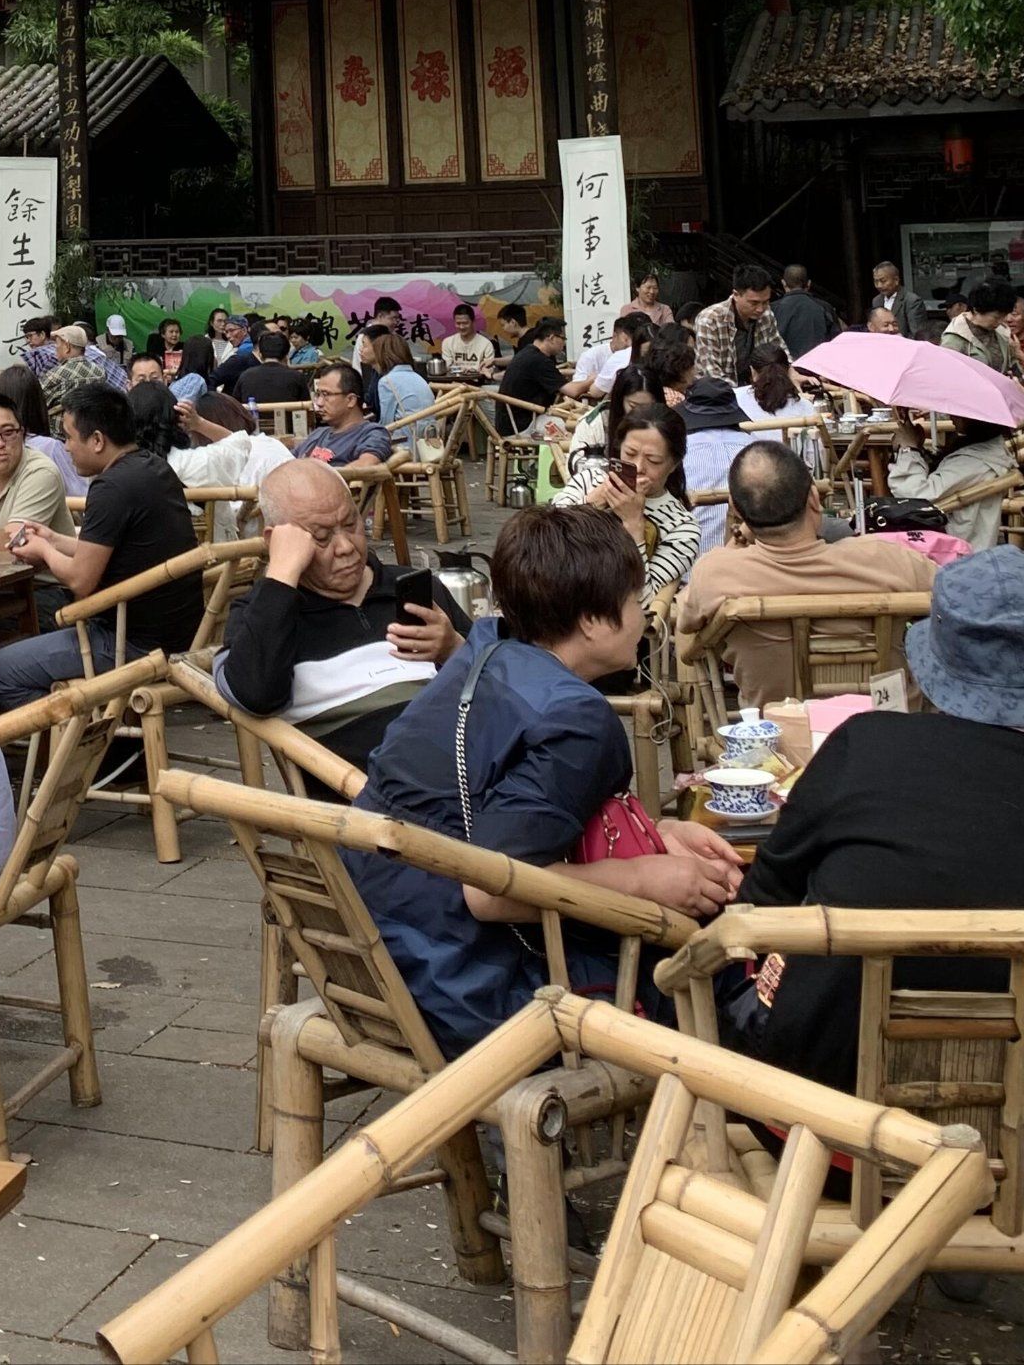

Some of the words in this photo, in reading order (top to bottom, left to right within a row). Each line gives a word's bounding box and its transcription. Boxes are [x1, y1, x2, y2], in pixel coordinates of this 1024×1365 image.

[488, 45, 530, 98] 福
[454, 352, 478, 362] FILA
[874, 686, 890, 706] 24
